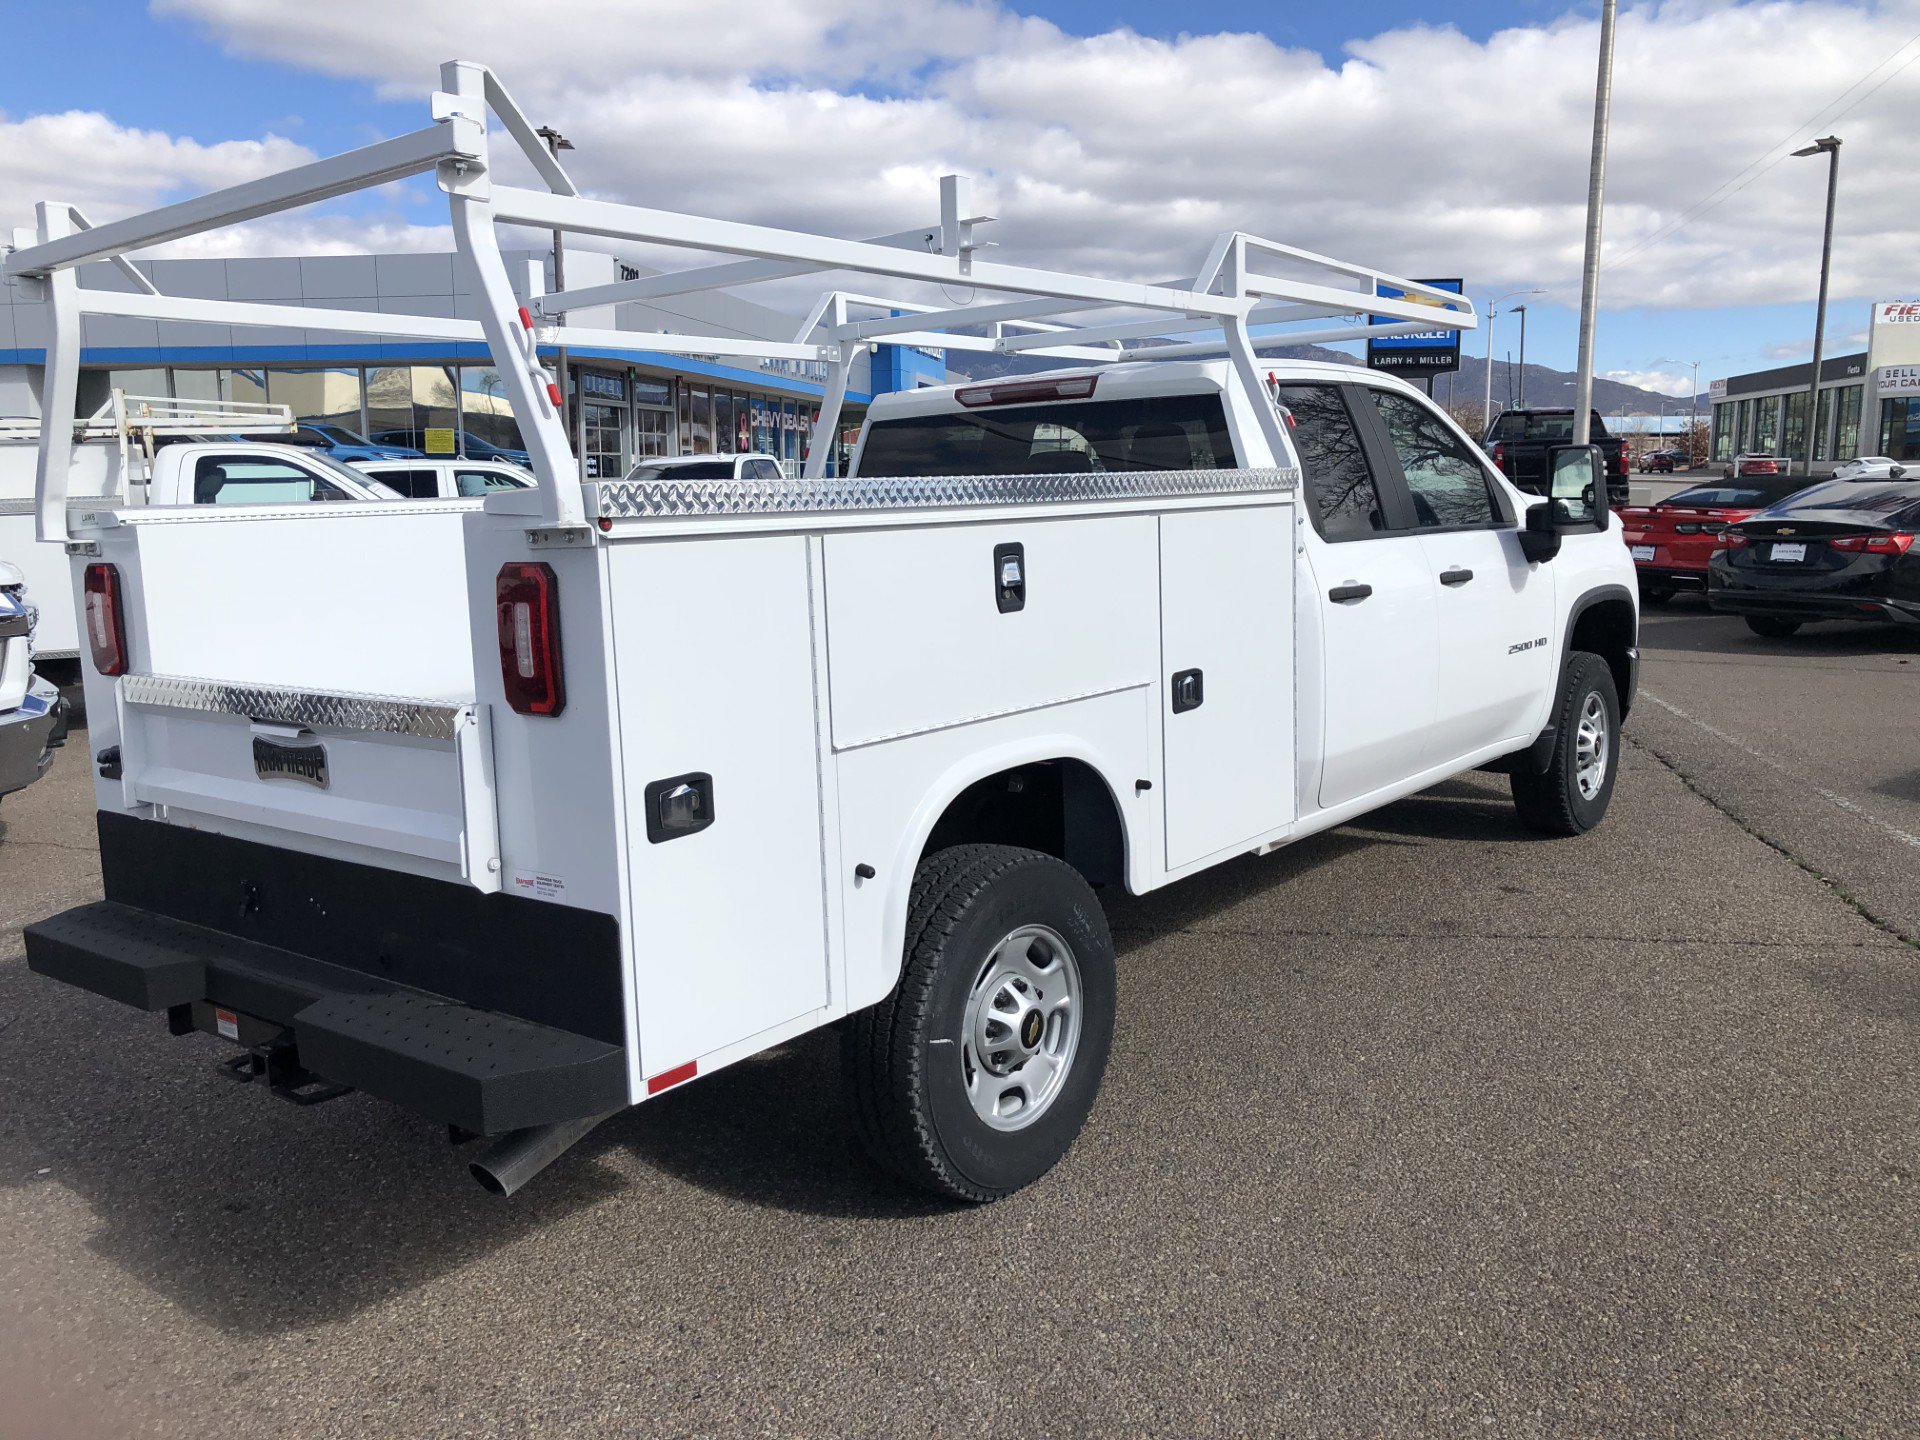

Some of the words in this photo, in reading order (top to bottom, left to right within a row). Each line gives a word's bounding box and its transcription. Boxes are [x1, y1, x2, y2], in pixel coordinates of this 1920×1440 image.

[620, 264, 639, 281] 7201
[1884, 304, 1920, 316] FIE
[1374, 357, 1403, 365] LARRY
[1419, 356, 1452, 364] MILLER
[1885, 368, 1917, 378] SELL
[584, 373, 623, 396] OPEN
[1900, 379, 1920, 388] CA
[750, 408, 781, 429] CHEVY
[1508, 640, 1532, 655] 2500
[1534, 636, 1547, 648] HD
